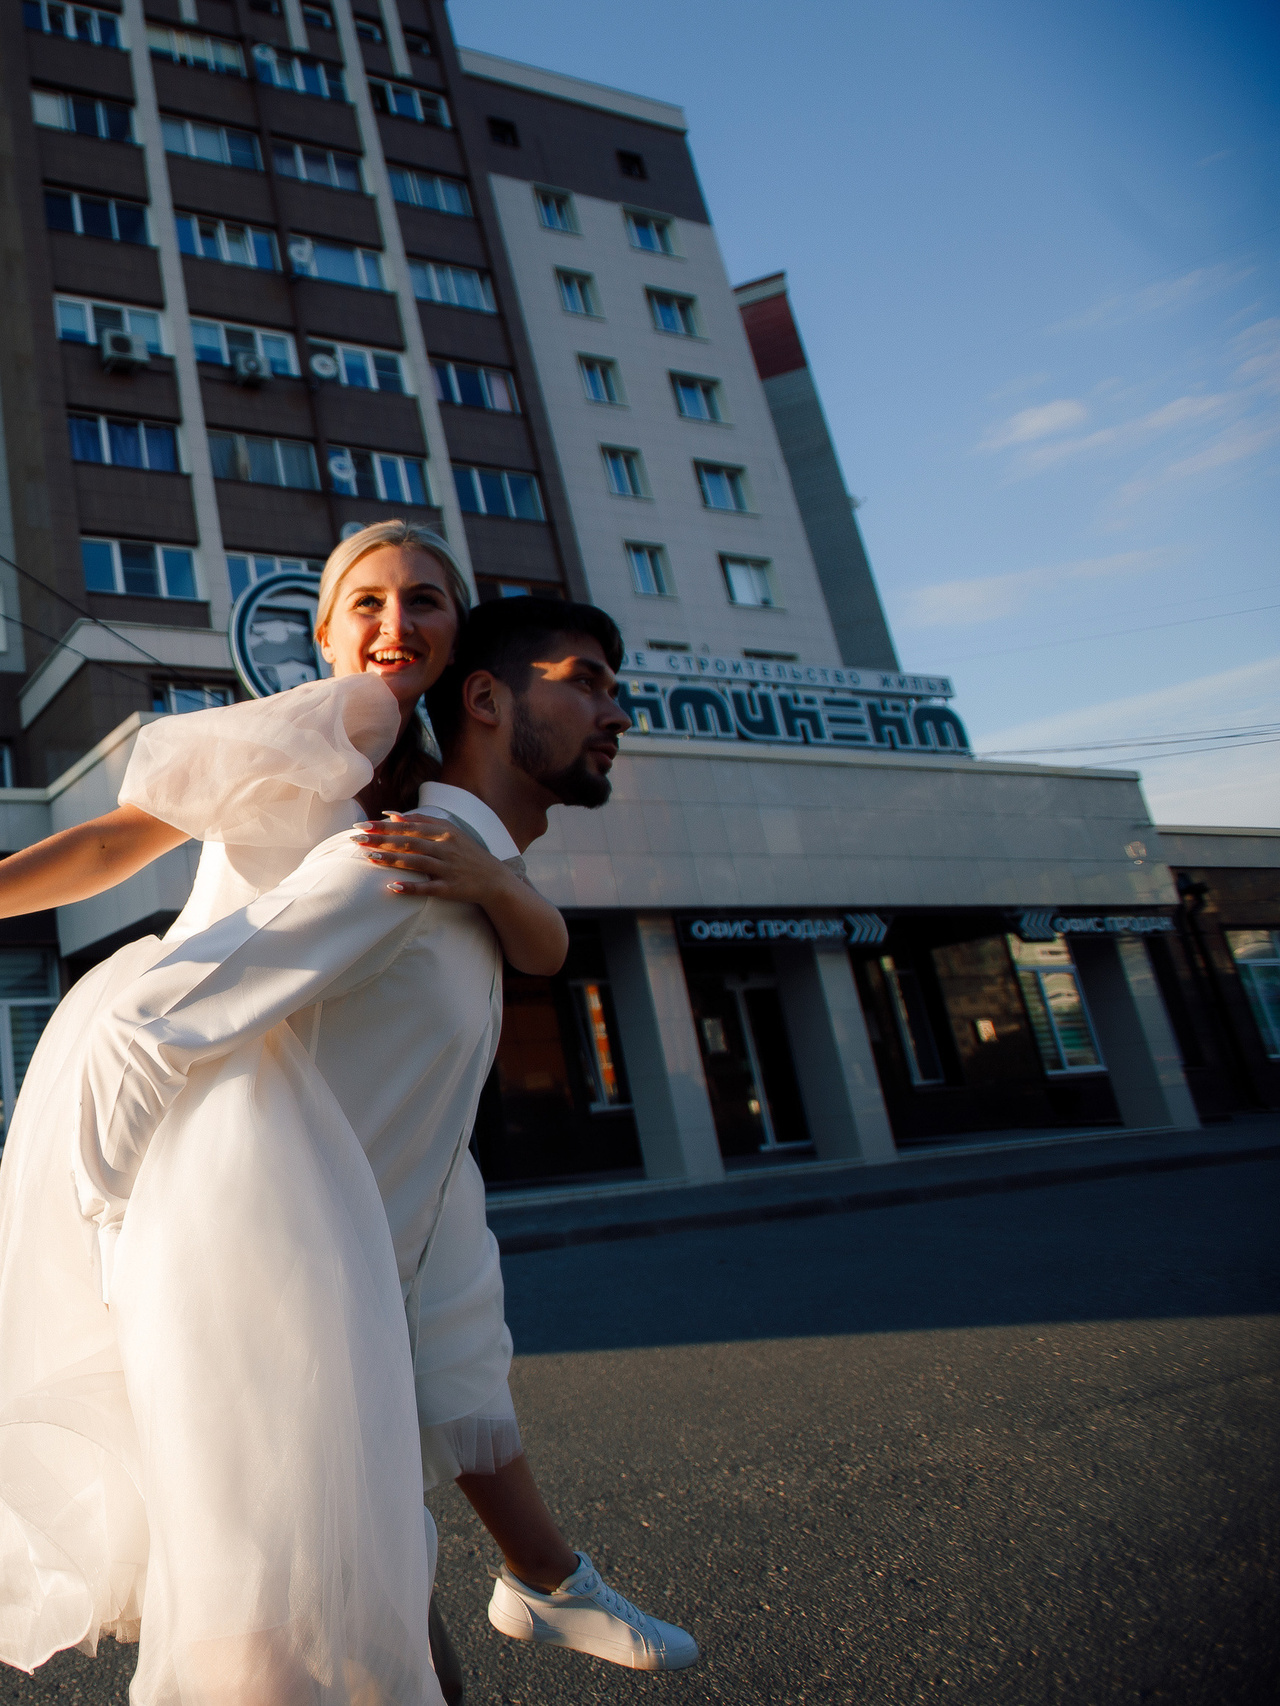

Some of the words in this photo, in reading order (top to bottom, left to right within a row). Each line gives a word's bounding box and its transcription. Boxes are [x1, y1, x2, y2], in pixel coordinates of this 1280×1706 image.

[669, 655, 862, 686] СТРОИТЕЛЬСТВО
[880, 673, 952, 693] ЖИЛЬЯ
[691, 919, 756, 940] ОФИС
[757, 918, 848, 941] ПРОДАЖ
[1053, 916, 1105, 933] ОФИС
